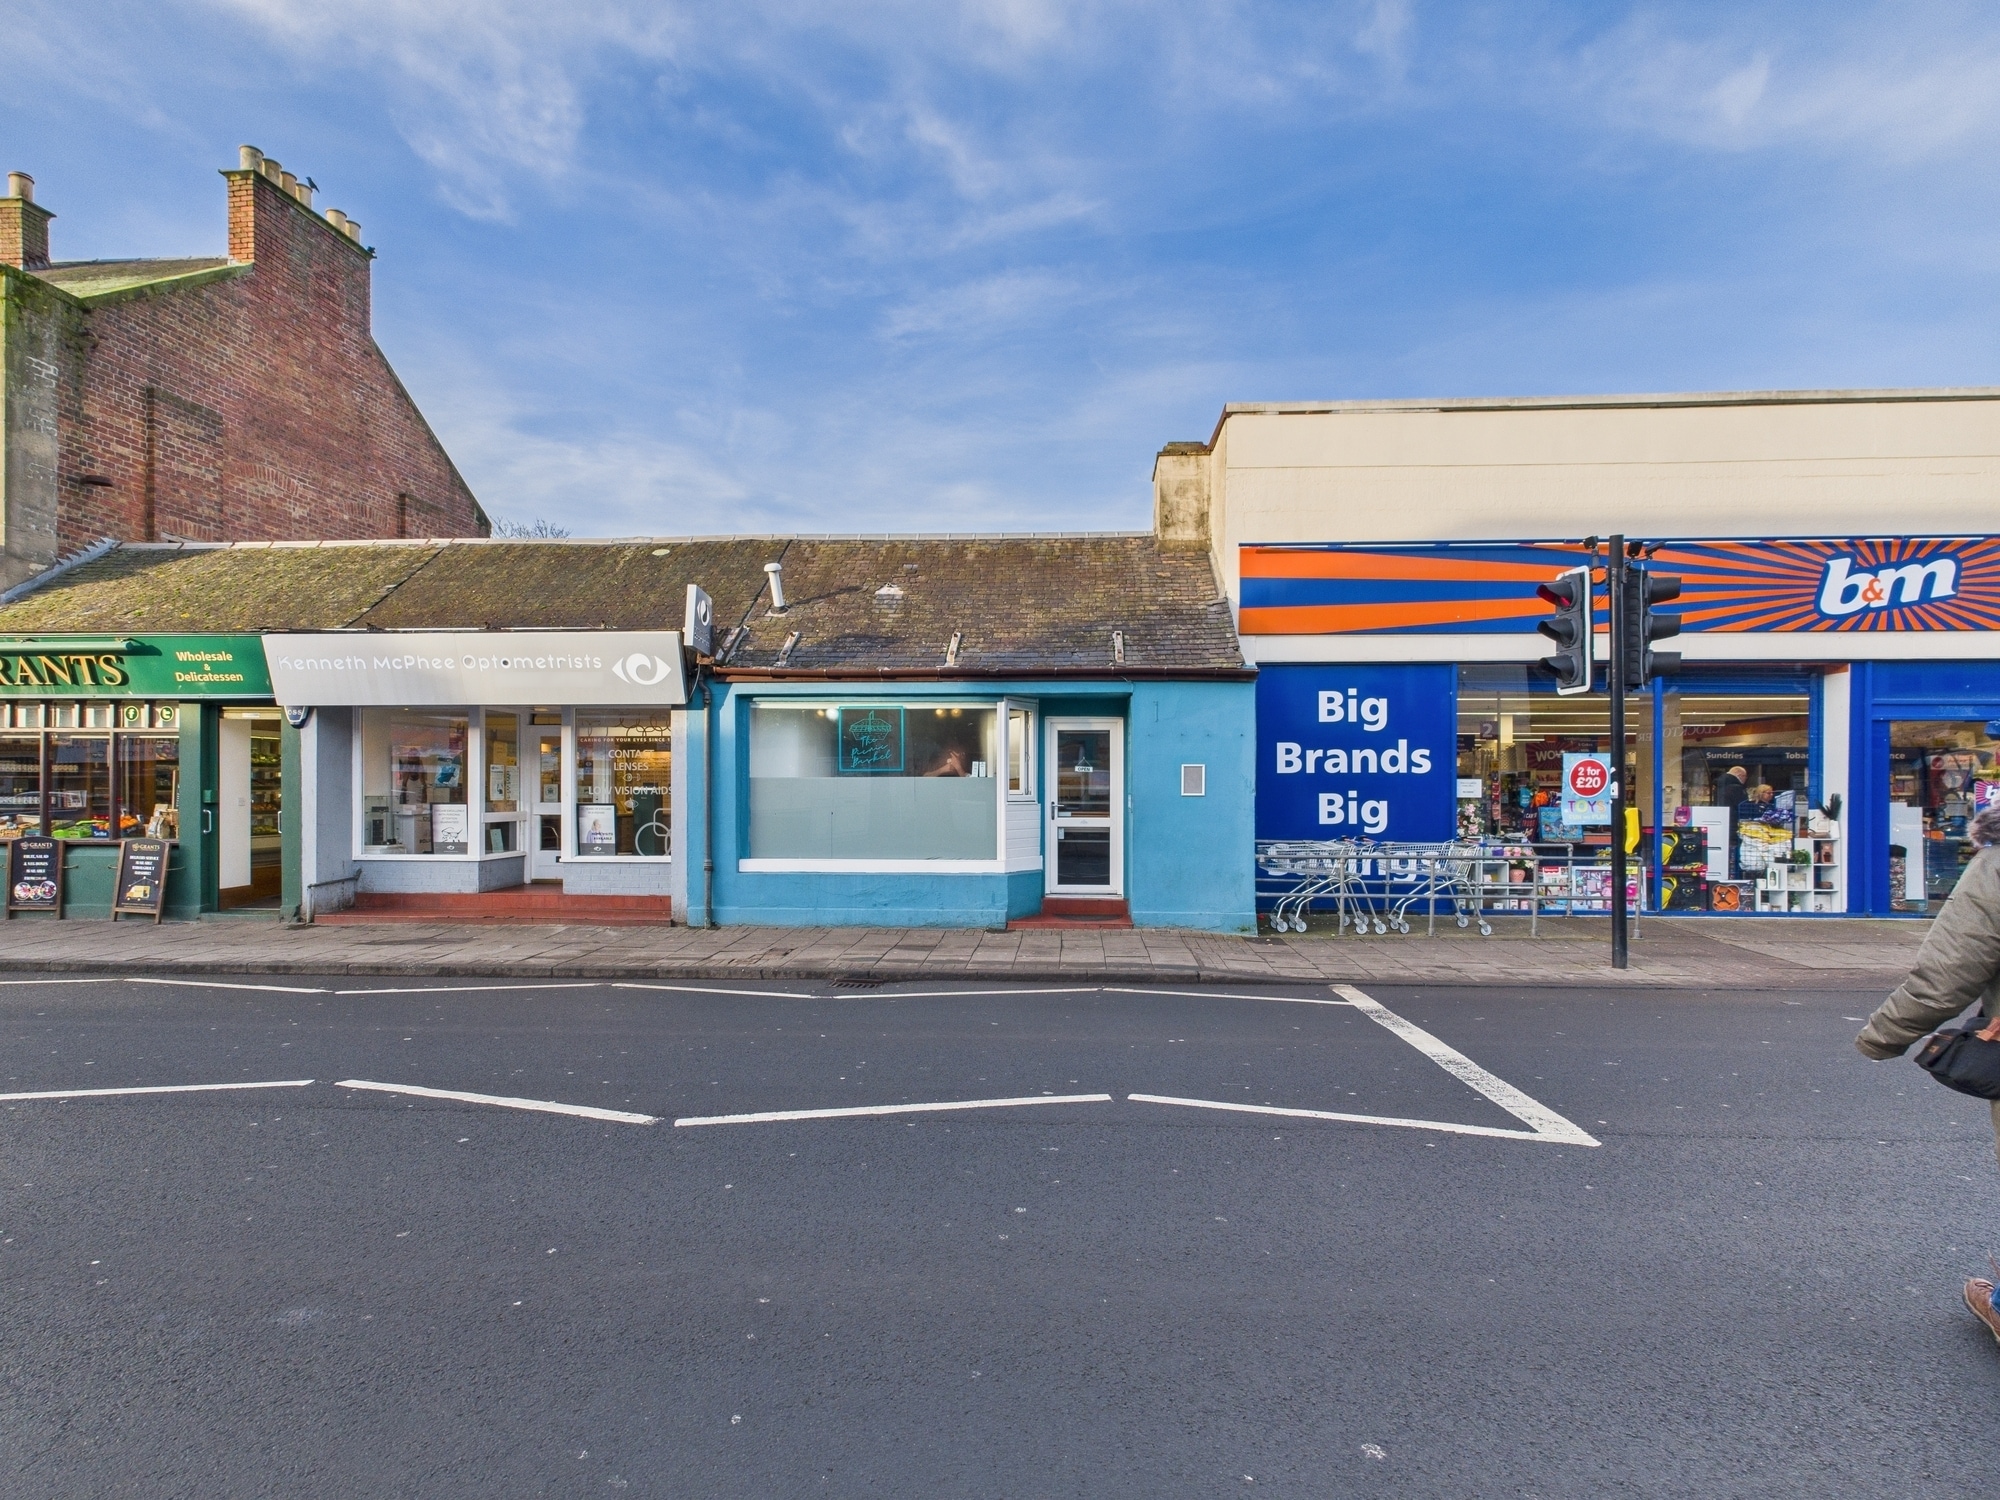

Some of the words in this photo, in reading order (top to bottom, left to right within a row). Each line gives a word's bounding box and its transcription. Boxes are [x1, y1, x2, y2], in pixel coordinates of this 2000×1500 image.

[1820, 557, 1956, 616] b&m
[175, 651, 233, 662] Wholesale
[203, 663, 211, 671] &
[276, 655, 367, 670] Kenneth
[373, 655, 455, 669] McPhee
[462, 654, 602, 672] Optometrists
[174, 671, 244, 682] Delicatessen
[1318, 687, 1389, 732] Big
[1482, 722, 1493, 738] 2
[608, 749, 655, 759] CONTACT
[1276, 739, 1432, 774] Brands
[613, 762, 649, 771] LENSES
[1577, 766, 1585, 776] 2
[1586, 766, 1601, 776] for
[1575, 776, 1601, 788] £20
[614, 786, 648, 795] VISION
[1318, 790, 1389, 834] Big
[1567, 799, 1607, 813] TOYS
